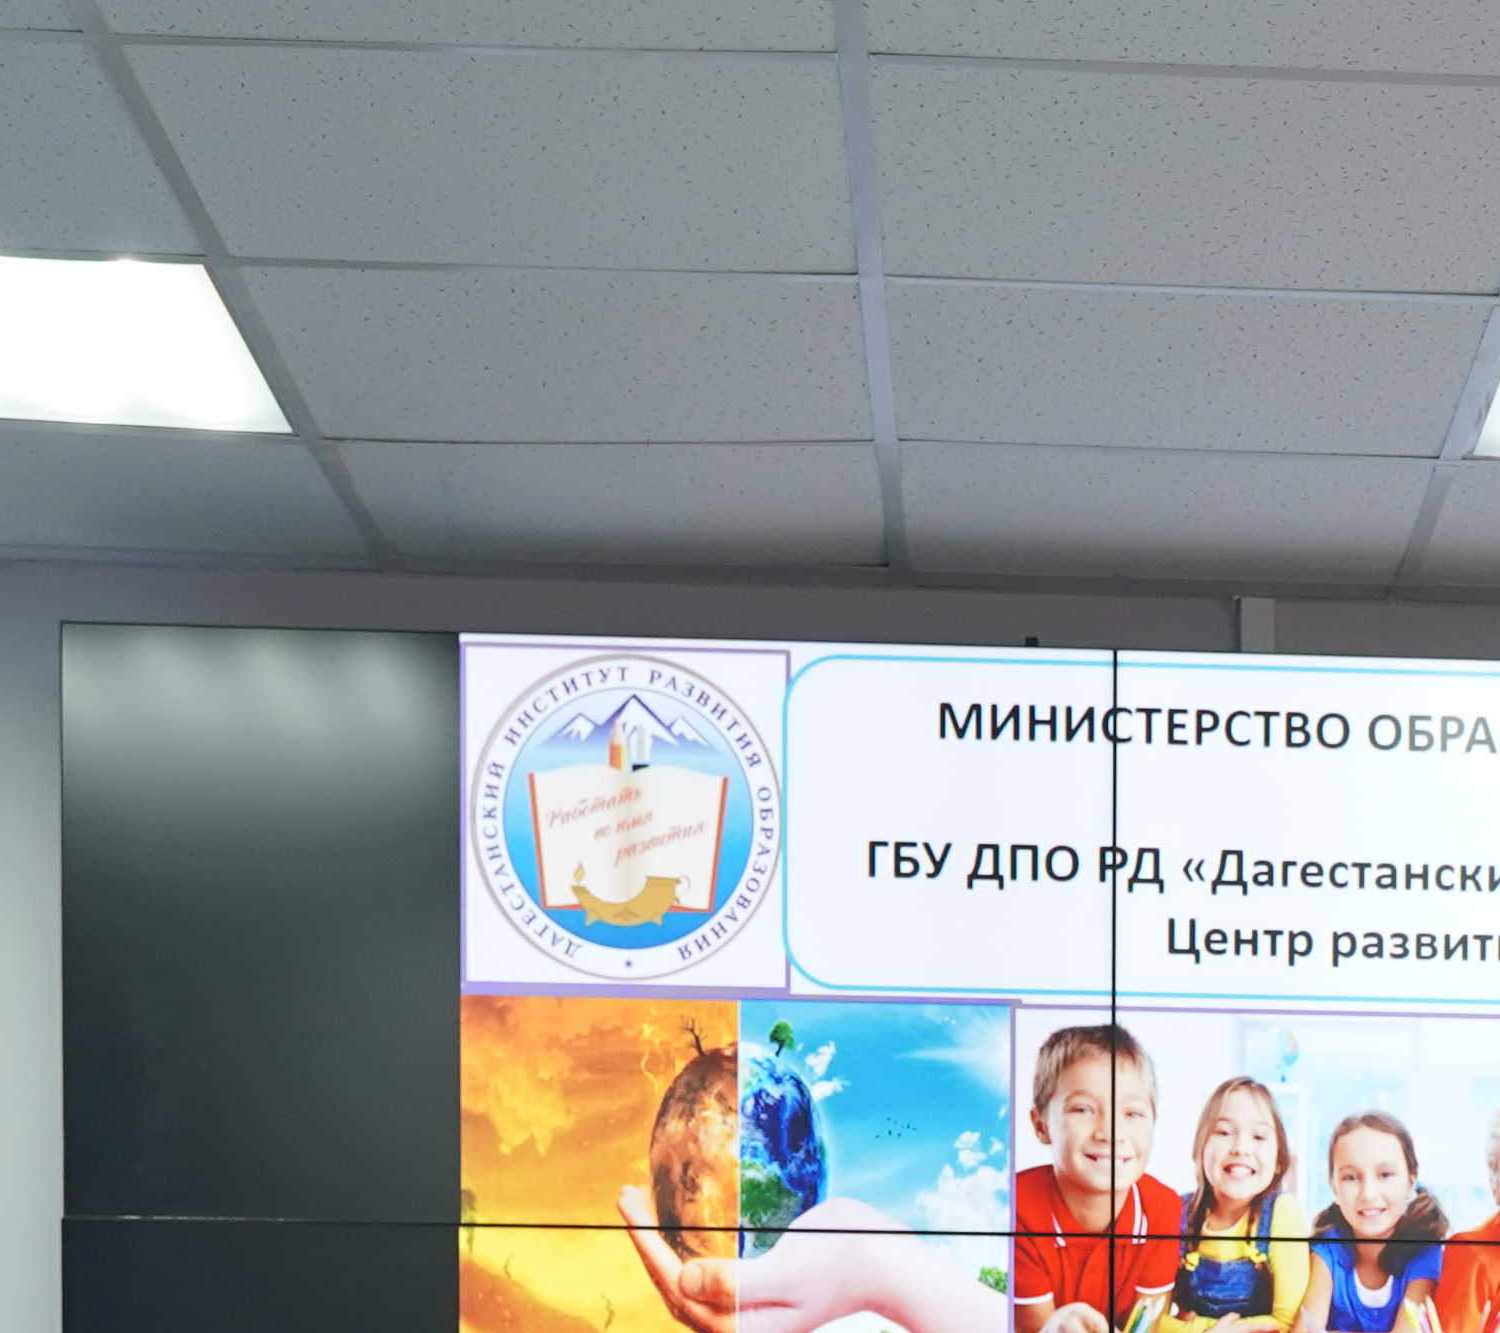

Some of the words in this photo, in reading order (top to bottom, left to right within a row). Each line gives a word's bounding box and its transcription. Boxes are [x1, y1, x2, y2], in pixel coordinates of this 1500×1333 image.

[503, 666, 631, 748] ИНСТИТУТ
[650, 669, 763, 770] РАЗВИТИЯ
[940, 702, 1350, 750] МИНИСТЕРСТВО
[482, 761, 583, 959] ДАГЕСТАНСКИЙ
[677, 786, 775, 961] ОБРАЗОВАНИЯ
[869, 841, 952, 880] ГБУ
[967, 844, 1080, 890] ДПО
[1100, 846, 1165, 895] РД
[1168, 917, 1314, 967] Центр
